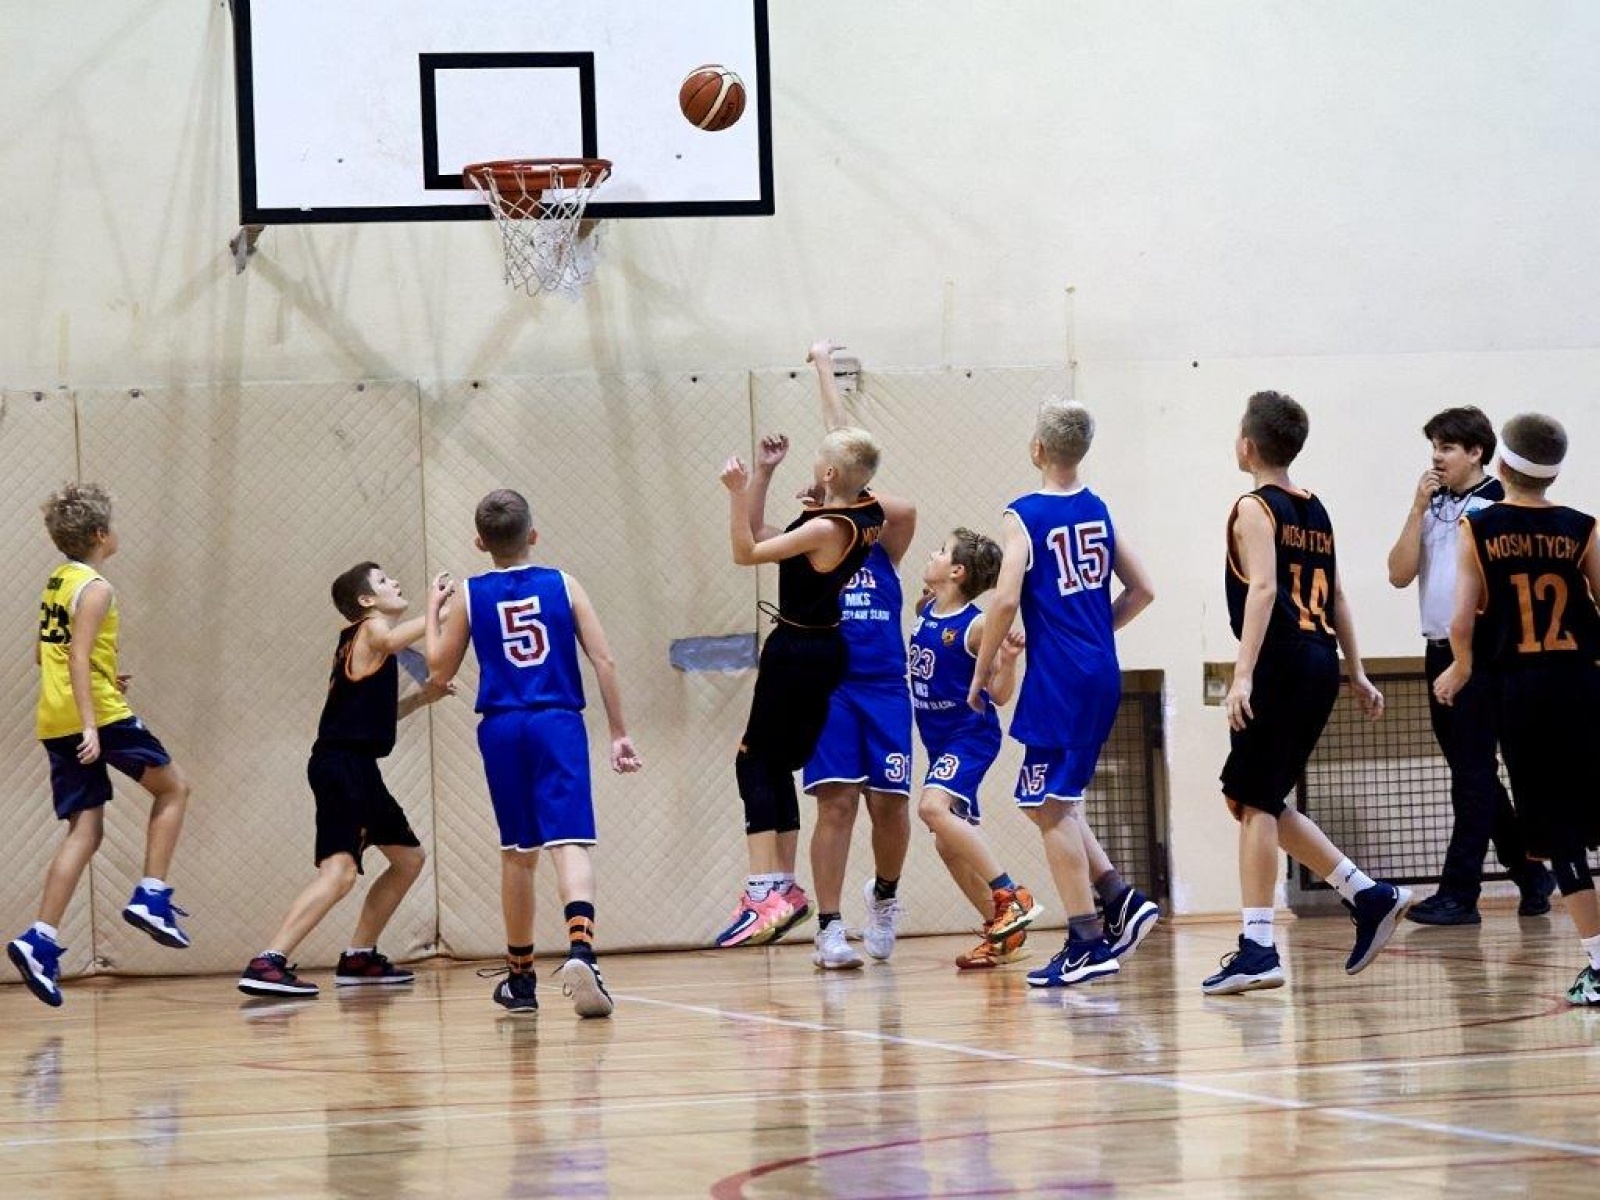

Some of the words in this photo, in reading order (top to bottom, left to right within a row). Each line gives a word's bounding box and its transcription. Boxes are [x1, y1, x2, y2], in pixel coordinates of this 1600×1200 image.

[1046, 521, 1109, 596] 15
[1485, 534, 1532, 561] MOSM
[496, 594, 551, 668] 5
[844, 592, 871, 607] MKS
[1289, 562, 1336, 635] 14
[1510, 572, 1579, 653] 12
[910, 643, 936, 680] 23
